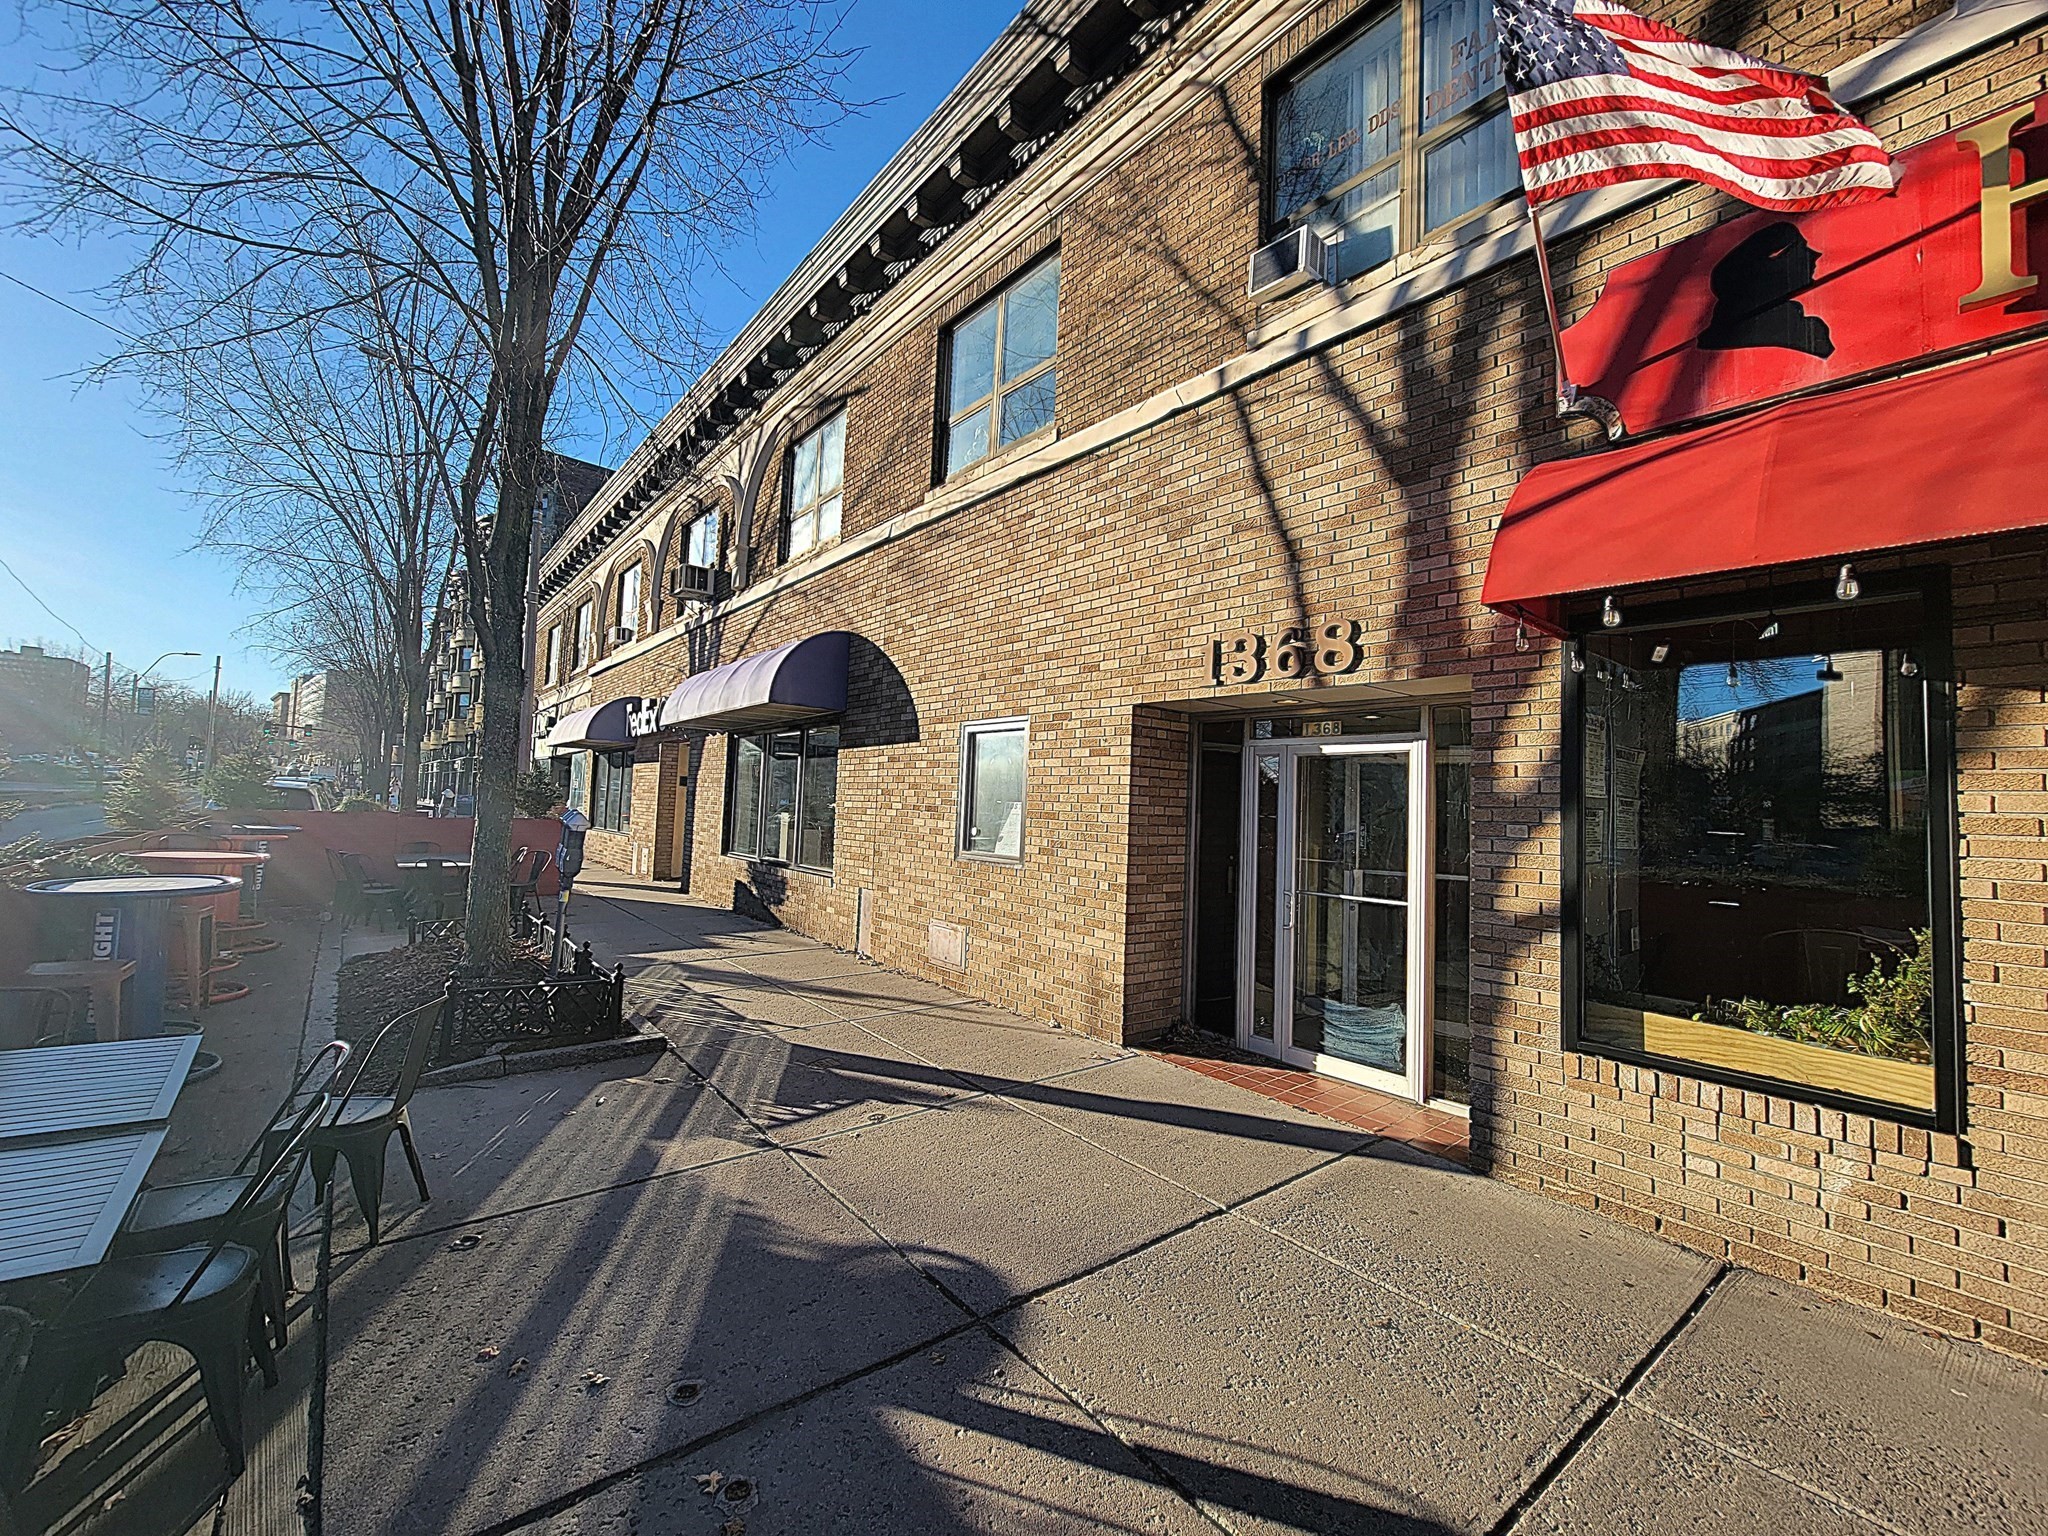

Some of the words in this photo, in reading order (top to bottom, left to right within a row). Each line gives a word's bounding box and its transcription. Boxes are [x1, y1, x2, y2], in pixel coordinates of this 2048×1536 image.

[1201, 618, 1362, 685] 1368
[626, 698, 659, 737] FedEx
[1305, 722, 1340, 735] 1368
[93, 914, 114, 960] IGHT
